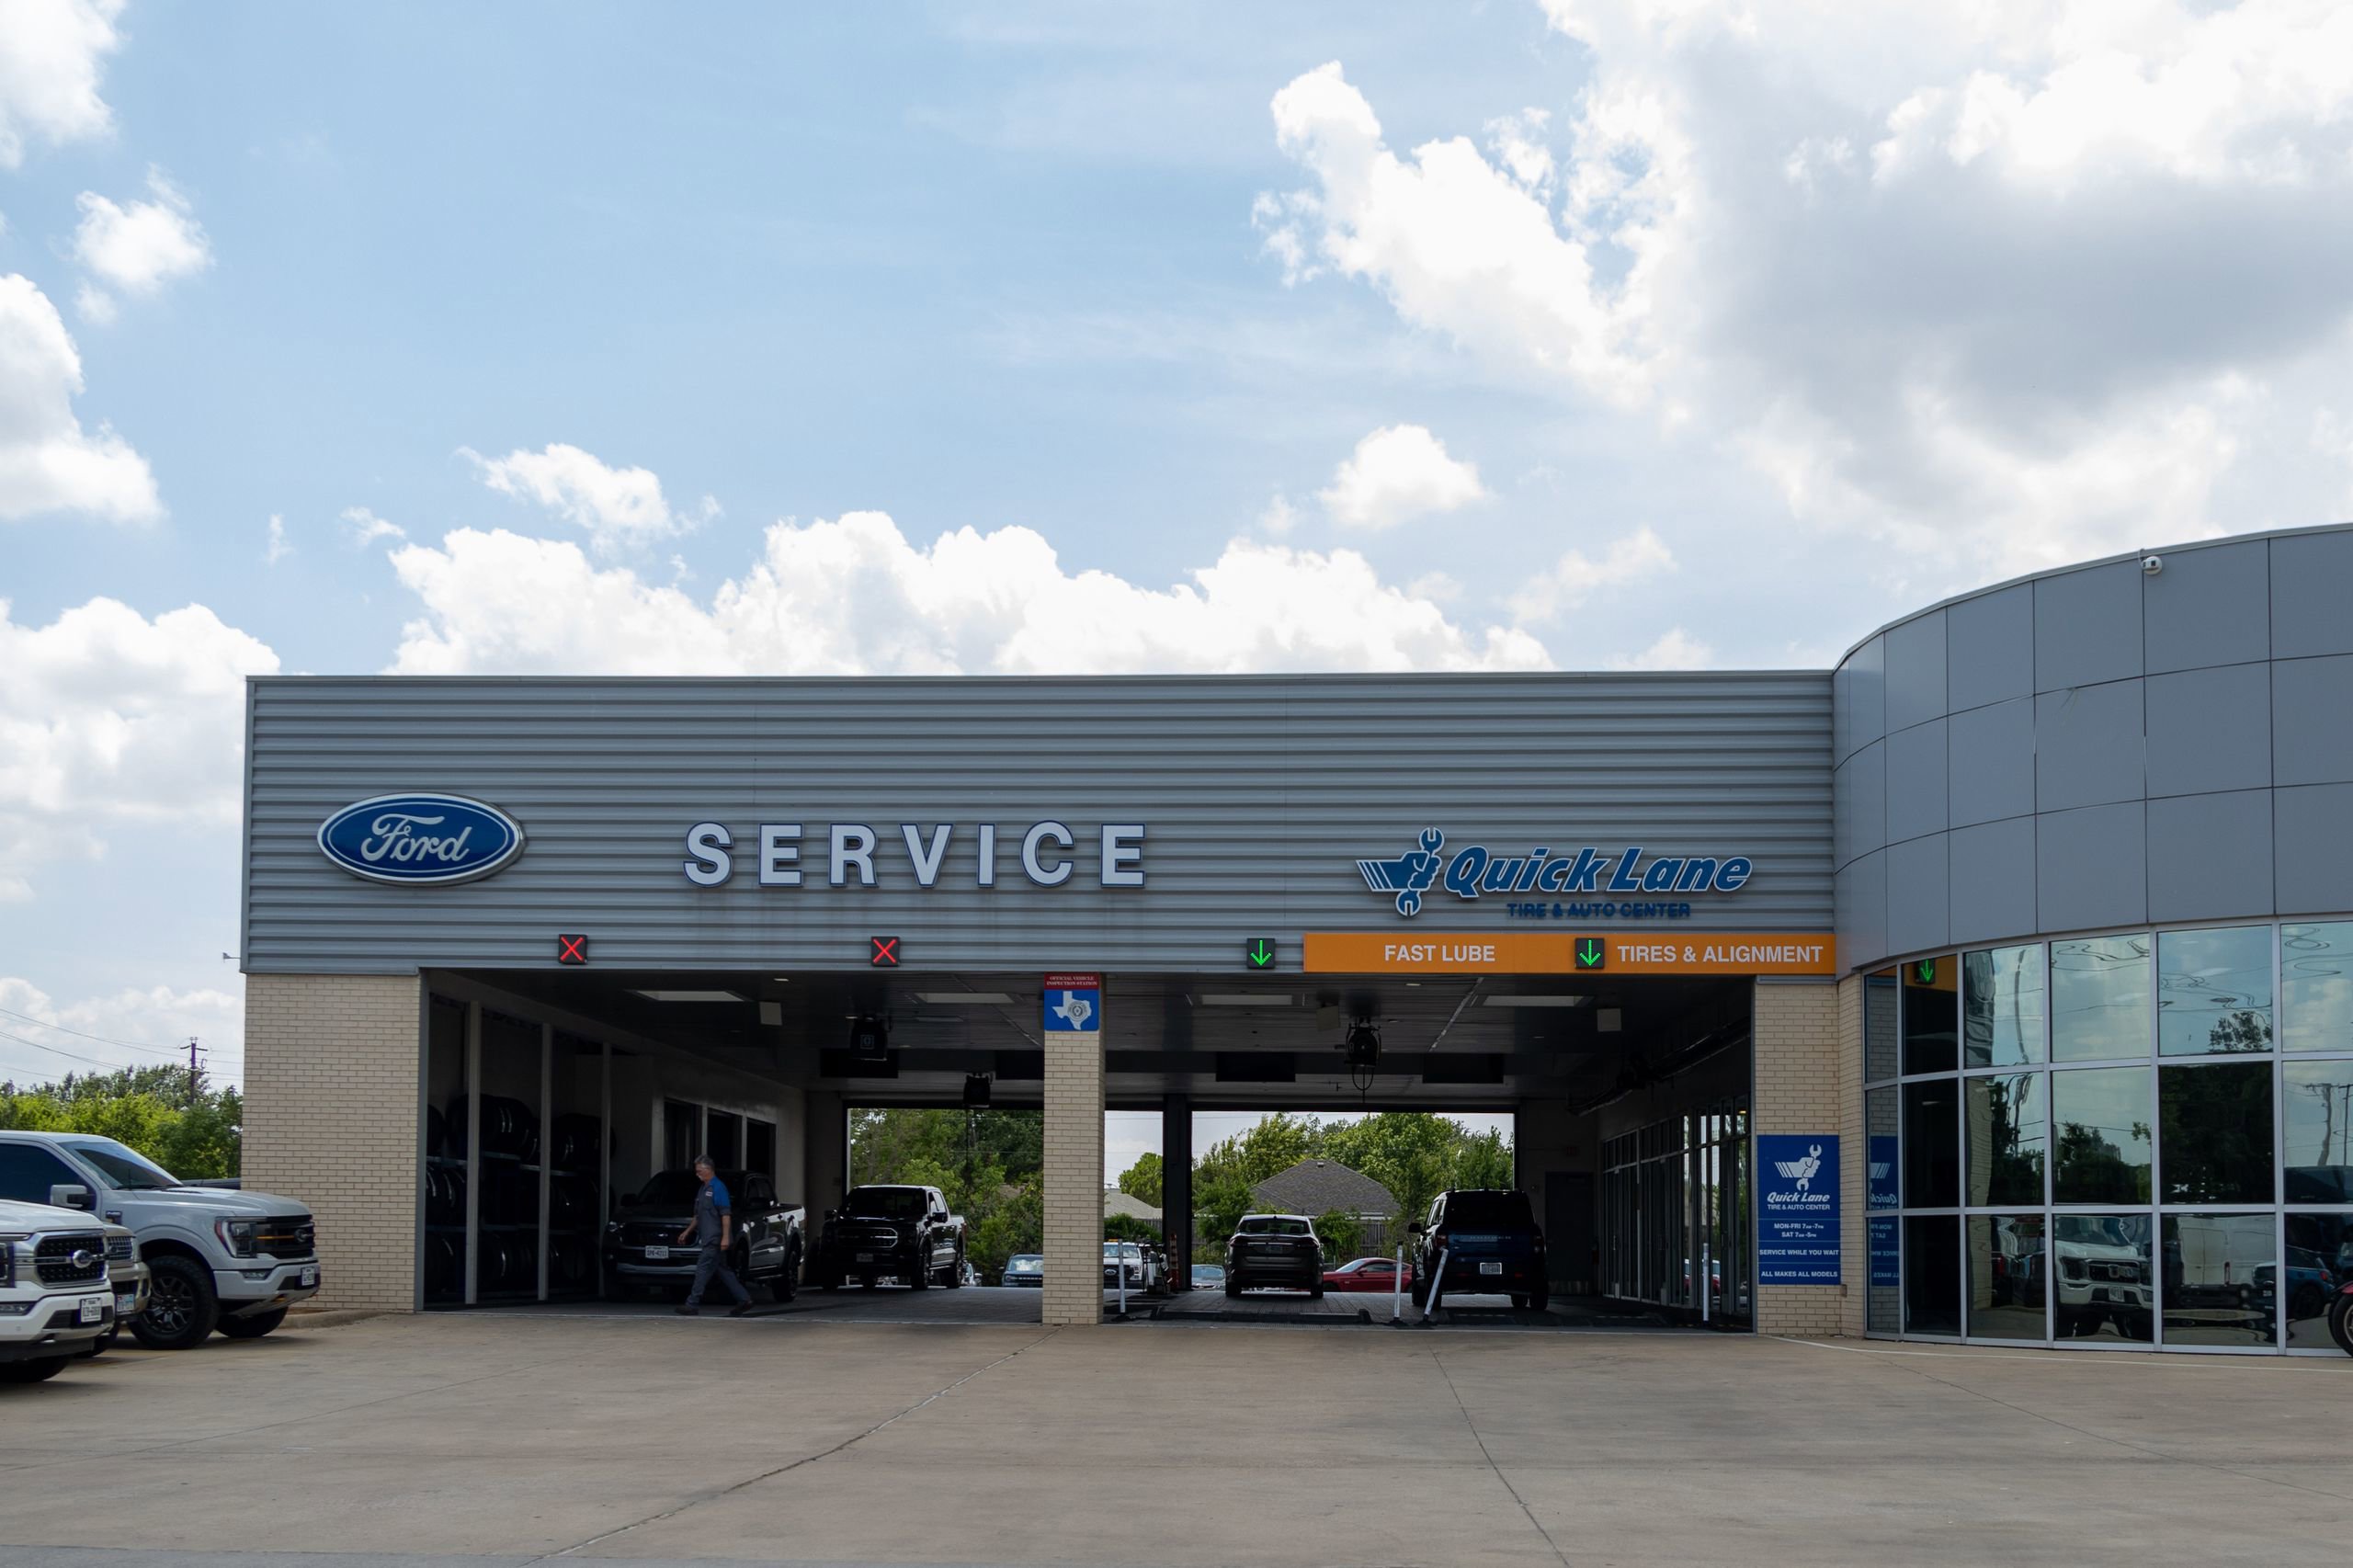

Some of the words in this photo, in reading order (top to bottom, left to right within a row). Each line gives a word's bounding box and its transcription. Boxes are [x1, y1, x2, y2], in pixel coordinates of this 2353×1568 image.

[360, 813, 473, 861] Ford
[683, 820, 1146, 888] SERVICE
[1443, 845, 1612, 898] Quick
[1606, 846, 1754, 892] Lane
[1506, 903, 1547, 917] TIRE
[1552, 903, 1563, 917] &
[1567, 903, 1616, 917] AUTO
[1620, 903, 1691, 917] CENTER
[1384, 945, 1436, 962] FAST
[1441, 945, 1495, 962] LUBE
[1618, 945, 1677, 962] TIRES
[1683, 945, 1697, 962] &
[1703, 945, 1824, 962] ALIGNMENT
[1767, 1191, 1801, 1203] Quick
[1801, 1192, 1830, 1202] Lane
